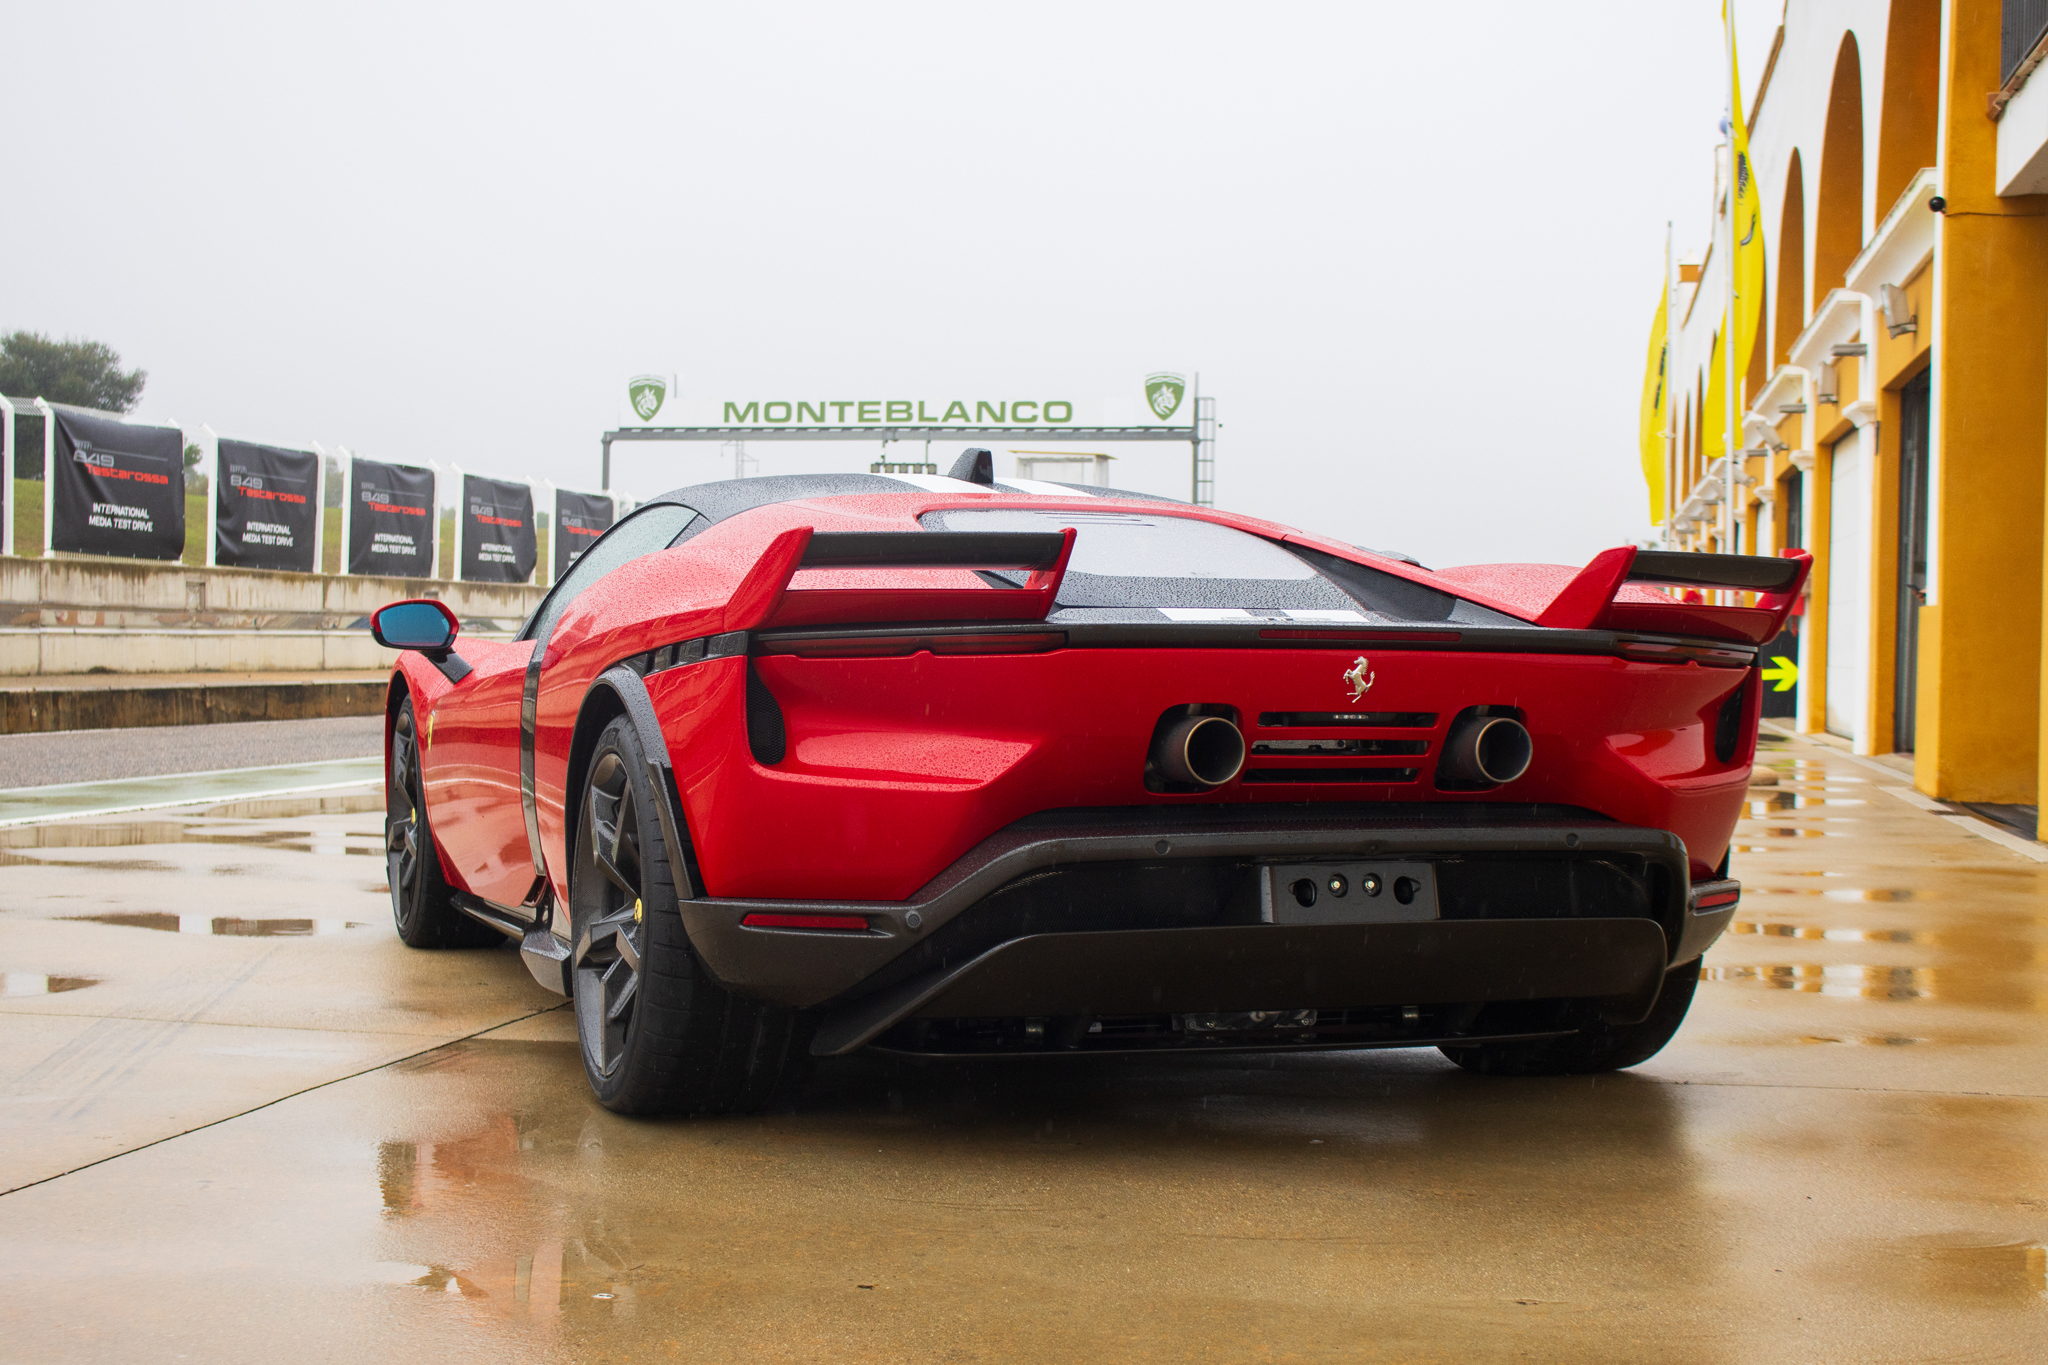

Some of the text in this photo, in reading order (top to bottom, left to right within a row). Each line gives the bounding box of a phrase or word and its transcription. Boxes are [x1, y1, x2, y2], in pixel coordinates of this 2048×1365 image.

[724, 401, 1073, 424] MONTEBLANCO
[73, 449, 114, 467] 849
[84, 463, 168, 485] Testarossa
[230, 474, 263, 489] 849
[237, 486, 306, 504] Testarossa
[361, 491, 389, 504] 849
[93, 502, 149, 519] INTERNATIONAL
[368, 501, 426, 516] Testarossa
[88, 514, 153, 532] MEDIA TEST DRIVE
[246, 521, 292, 535] INTERNATIONAL
[242, 532, 294, 547] MEDIA TEST DRIVE
[374, 533, 414, 545] INTERNATIONAL
[371, 543, 417, 556] MEDIA TEST DRIVE
